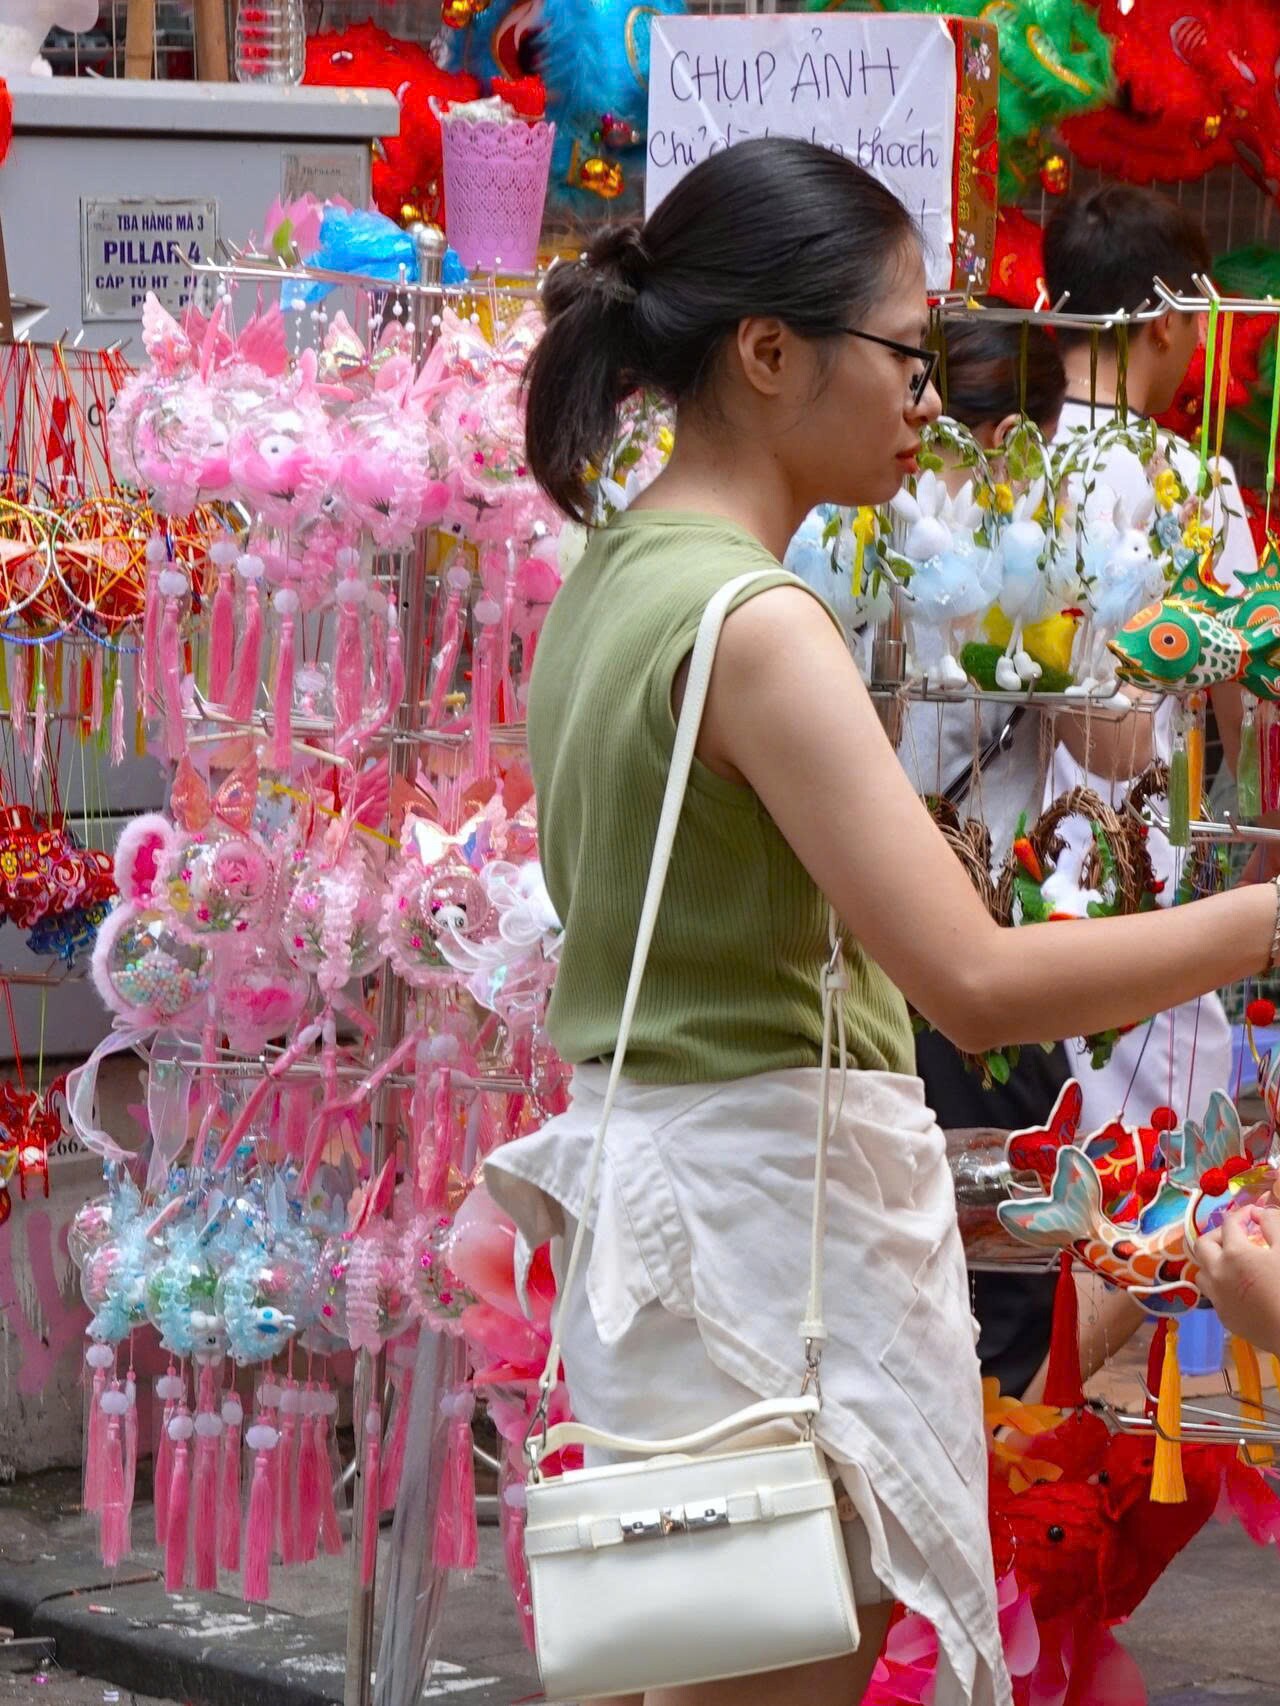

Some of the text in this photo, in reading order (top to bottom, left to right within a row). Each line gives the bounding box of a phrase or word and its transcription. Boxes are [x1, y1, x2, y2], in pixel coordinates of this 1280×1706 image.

[670, 27, 899, 108] CHỤP ẢNH
[649, 125, 707, 168] Chỉ
[117, 213, 139, 231] TBA
[142, 209, 173, 231] HÀNG
[197, 214, 204, 231] 3
[104, 240, 200, 264] PILLAR 4
[151, 275, 169, 289] HT
